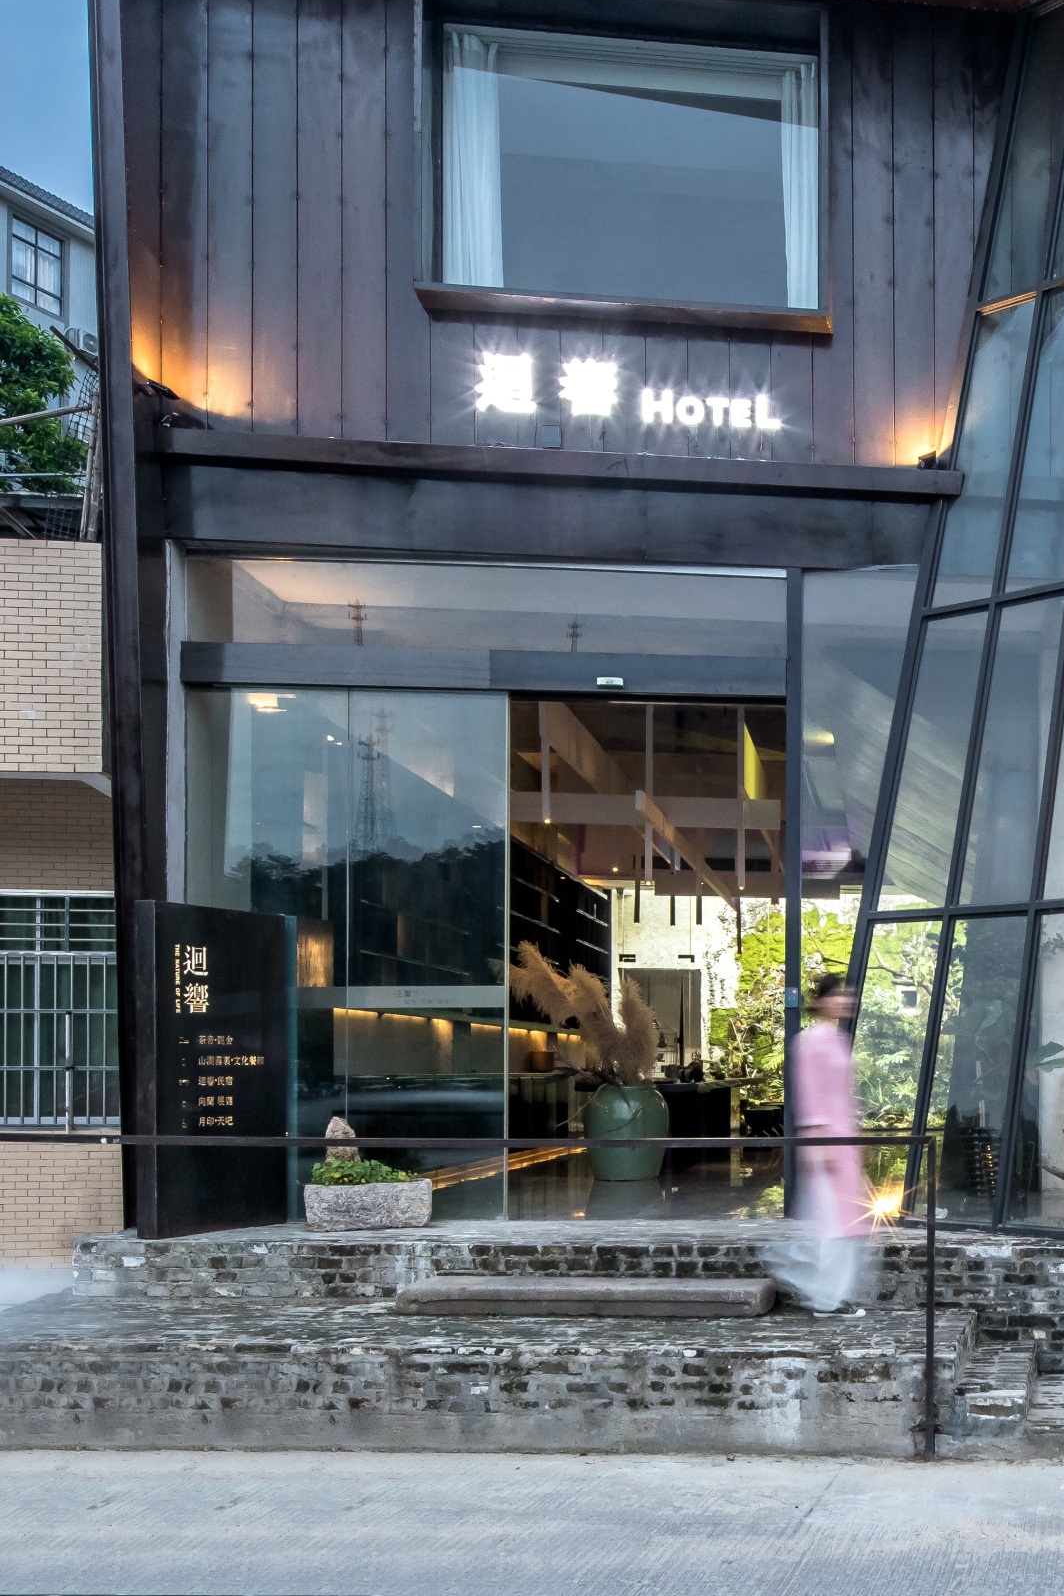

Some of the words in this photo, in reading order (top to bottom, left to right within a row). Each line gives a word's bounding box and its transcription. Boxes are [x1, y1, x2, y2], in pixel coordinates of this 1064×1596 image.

[642, 387, 782, 430] HOTEL
[175, 988, 181, 997] OF
[182, 945, 210, 1014] 迴響
